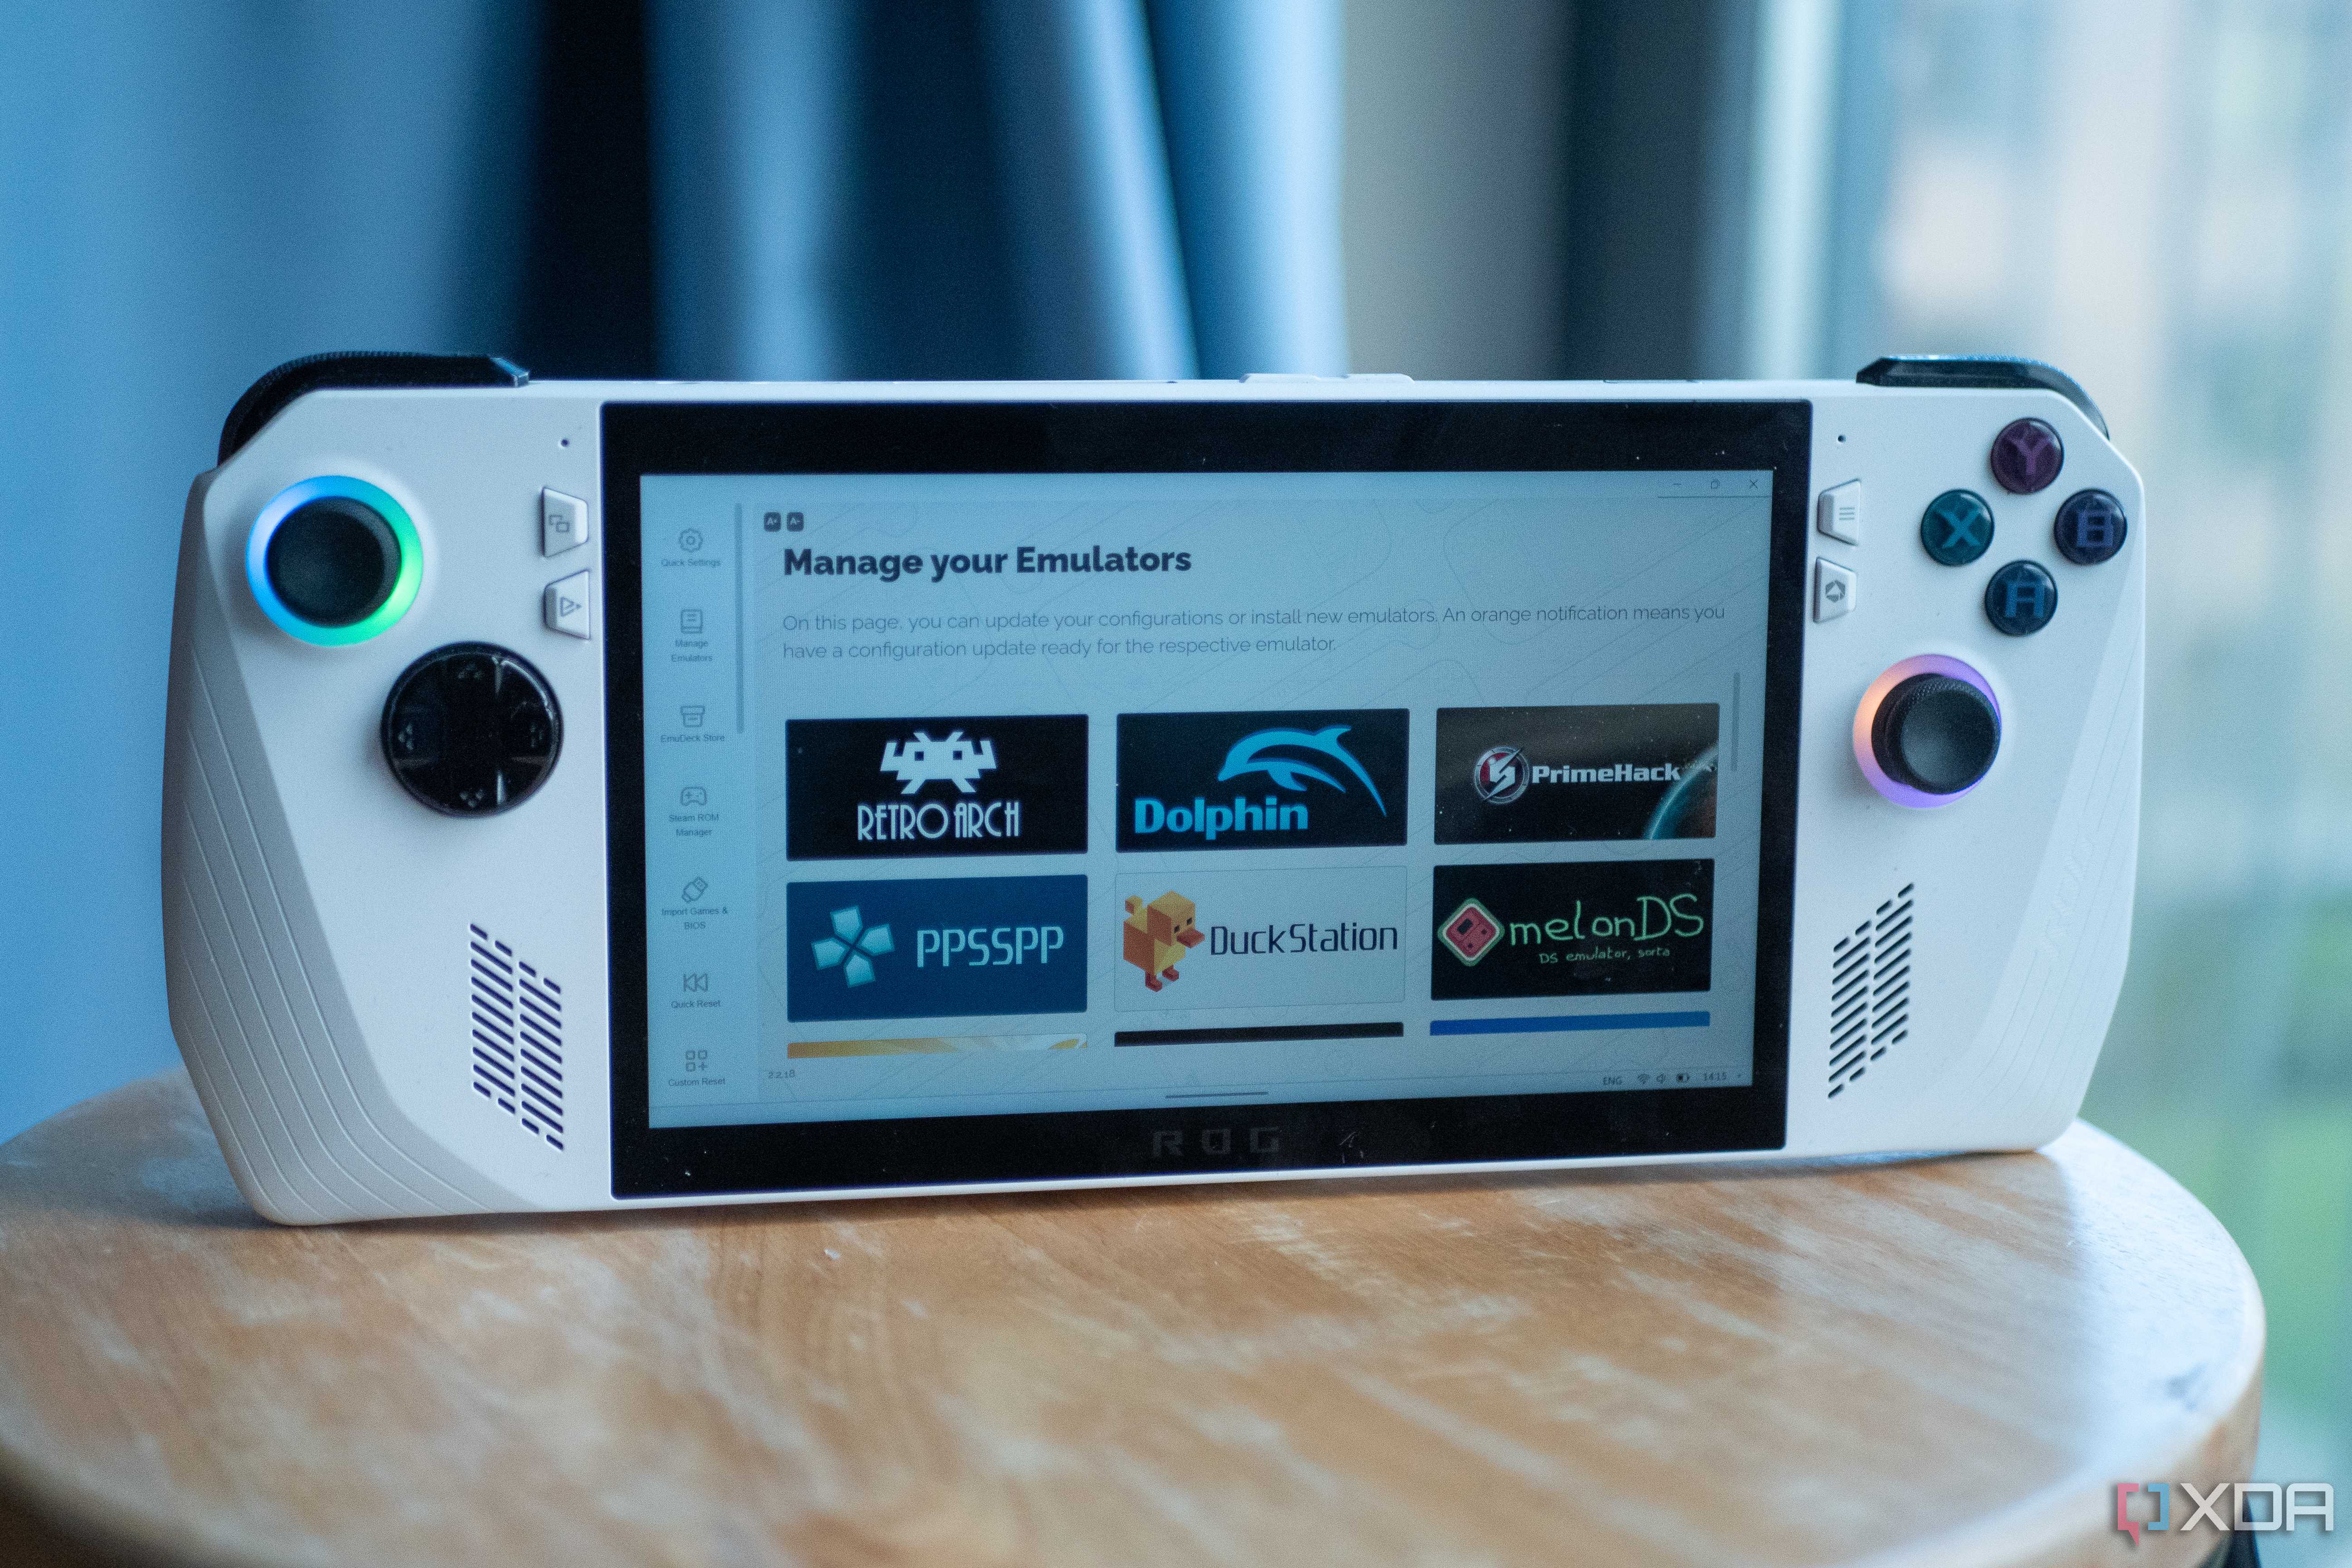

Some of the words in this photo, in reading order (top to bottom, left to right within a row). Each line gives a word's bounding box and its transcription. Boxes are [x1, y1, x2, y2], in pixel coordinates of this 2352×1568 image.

[2008, 434, 2052, 475] Y
[1932, 509, 1982, 548] X
[2077, 509, 2114, 548] B
[661, 559, 685, 568] Quick
[687, 559, 721, 568] Settings
[784, 548, 924, 583] Manage
[931, 553, 1008, 583] your
[1017, 545, 1192, 573] Emulators
[783, 615, 809, 631] On
[815, 615, 846, 630] this
[853, 617, 902, 633] page,
[908, 617, 942, 632] you
[947, 616, 980, 628] can
[986, 612, 1049, 632] update
[1054, 616, 1091, 631] your
[1098, 610, 1223, 630] configurations
[1229, 612, 1246, 624] or
[1251, 609, 1300, 624] install
[1306, 611, 1342, 624] new
[1348, 607, 1438, 623] emulators.
[1443, 608, 1465, 622] An
[1471, 608, 1532, 625] orange
[1537, 605, 1628, 622] notification
[1633, 607, 1690, 619] means
[1693, 607, 1724, 623] you
[675, 639, 709, 649] Manage
[784, 643, 827, 658] have
[833, 646, 843, 657] a
[848, 641, 966, 661] configuration
[973, 639, 1036, 659] update
[1042, 638, 1090, 658] ready
[1097, 638, 1120, 654] for
[1125, 638, 1154, 653] the
[1160, 636, 1251, 657] respective
[1256, 635, 1335, 652] emulator.
[1532, 763, 1681, 783] PrimeHack
[669, 814, 696, 822] Steam
[1135, 795, 1308, 840] Dolphin
[676, 828, 712, 837] Manager
[662, 908, 687, 916] Import
[683, 921, 706, 930] BIOS
[1510, 894, 1704, 946] melonDS
[917, 926, 1064, 968] PPSSPP
[1210, 922, 1398, 956] DuckStation
[1539, 953, 1558, 964] DS
[1566, 946, 1631, 961] emulator,
[1639, 946, 1670, 958] sorta
[1602, 1076, 1622, 1085] ENG
[1152, 1127, 1280, 1157] ROG
